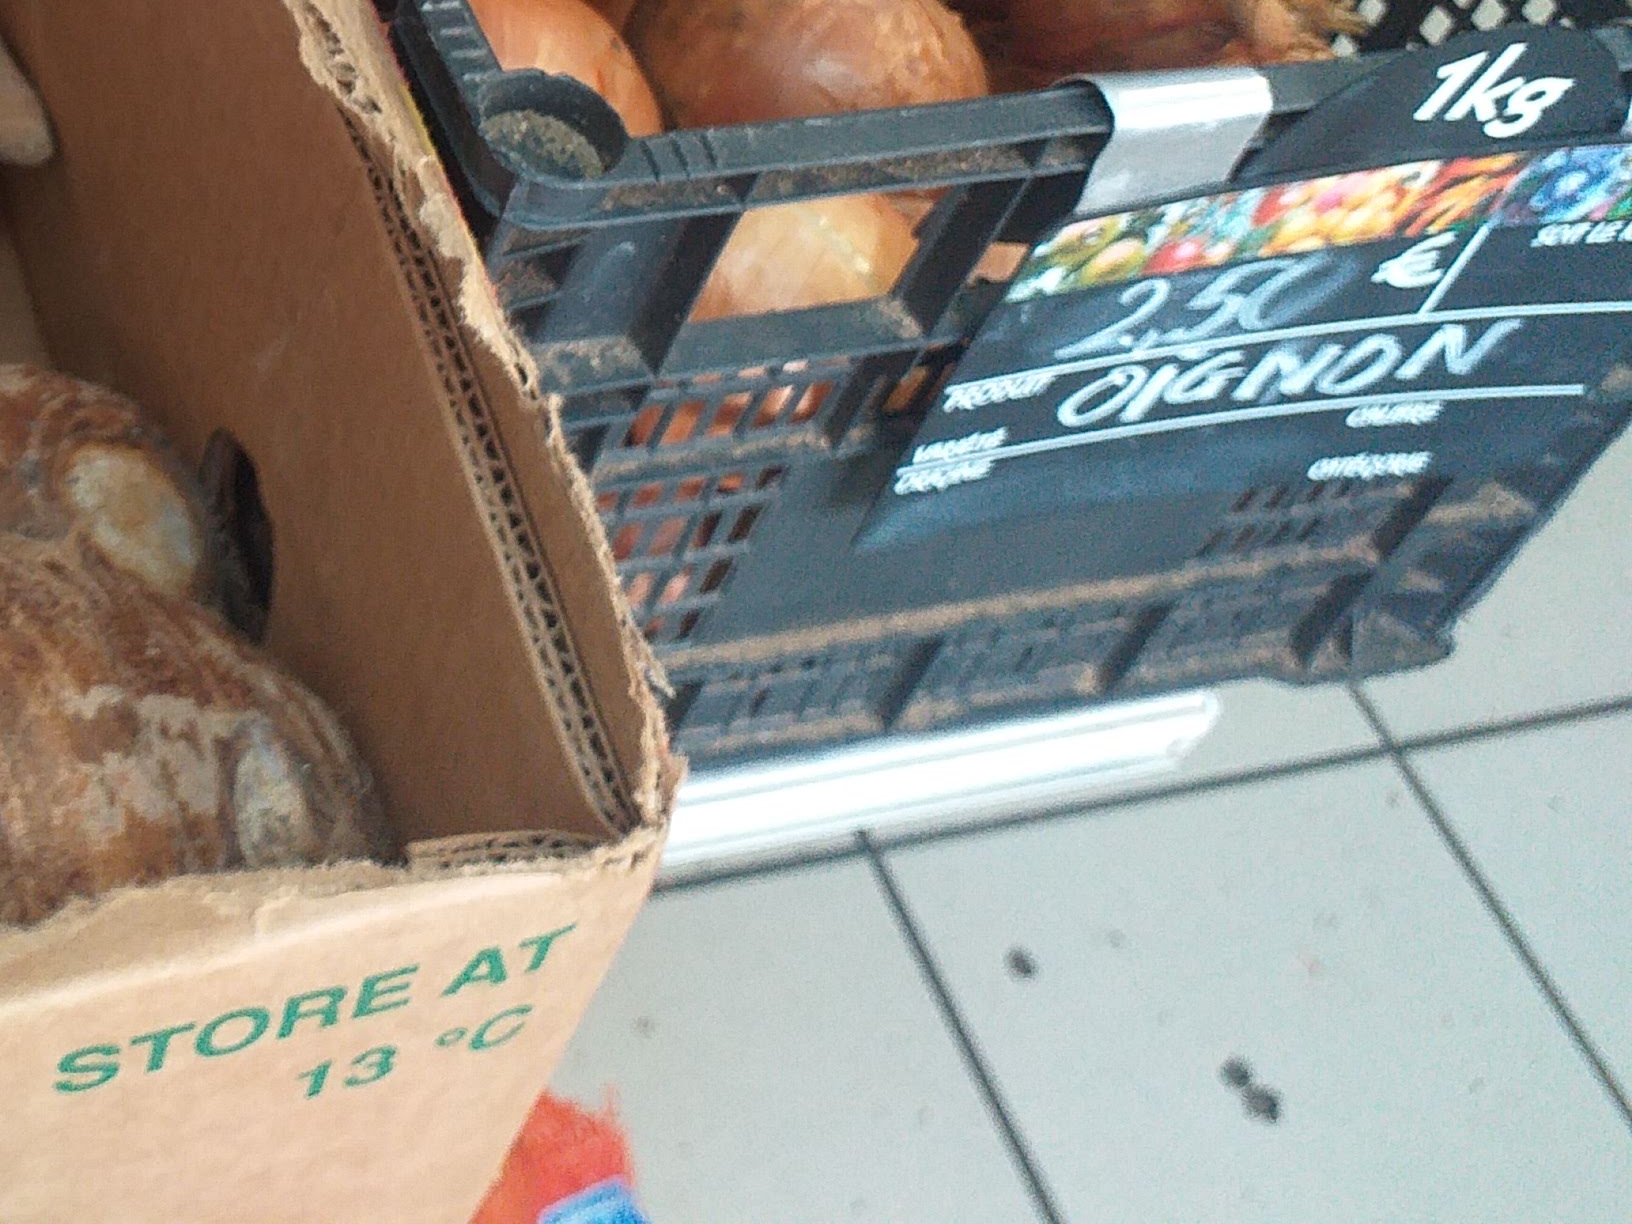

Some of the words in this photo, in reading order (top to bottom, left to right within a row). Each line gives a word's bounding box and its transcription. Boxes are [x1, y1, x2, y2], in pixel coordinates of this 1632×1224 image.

[1413, 42, 1574, 138] 1kg
[1058, 319, 1523, 427] OIGNON
[54, 964, 420, 1093] STORE
[441, 922, 578, 998] AT
[294, 1045, 398, 1098] 13
